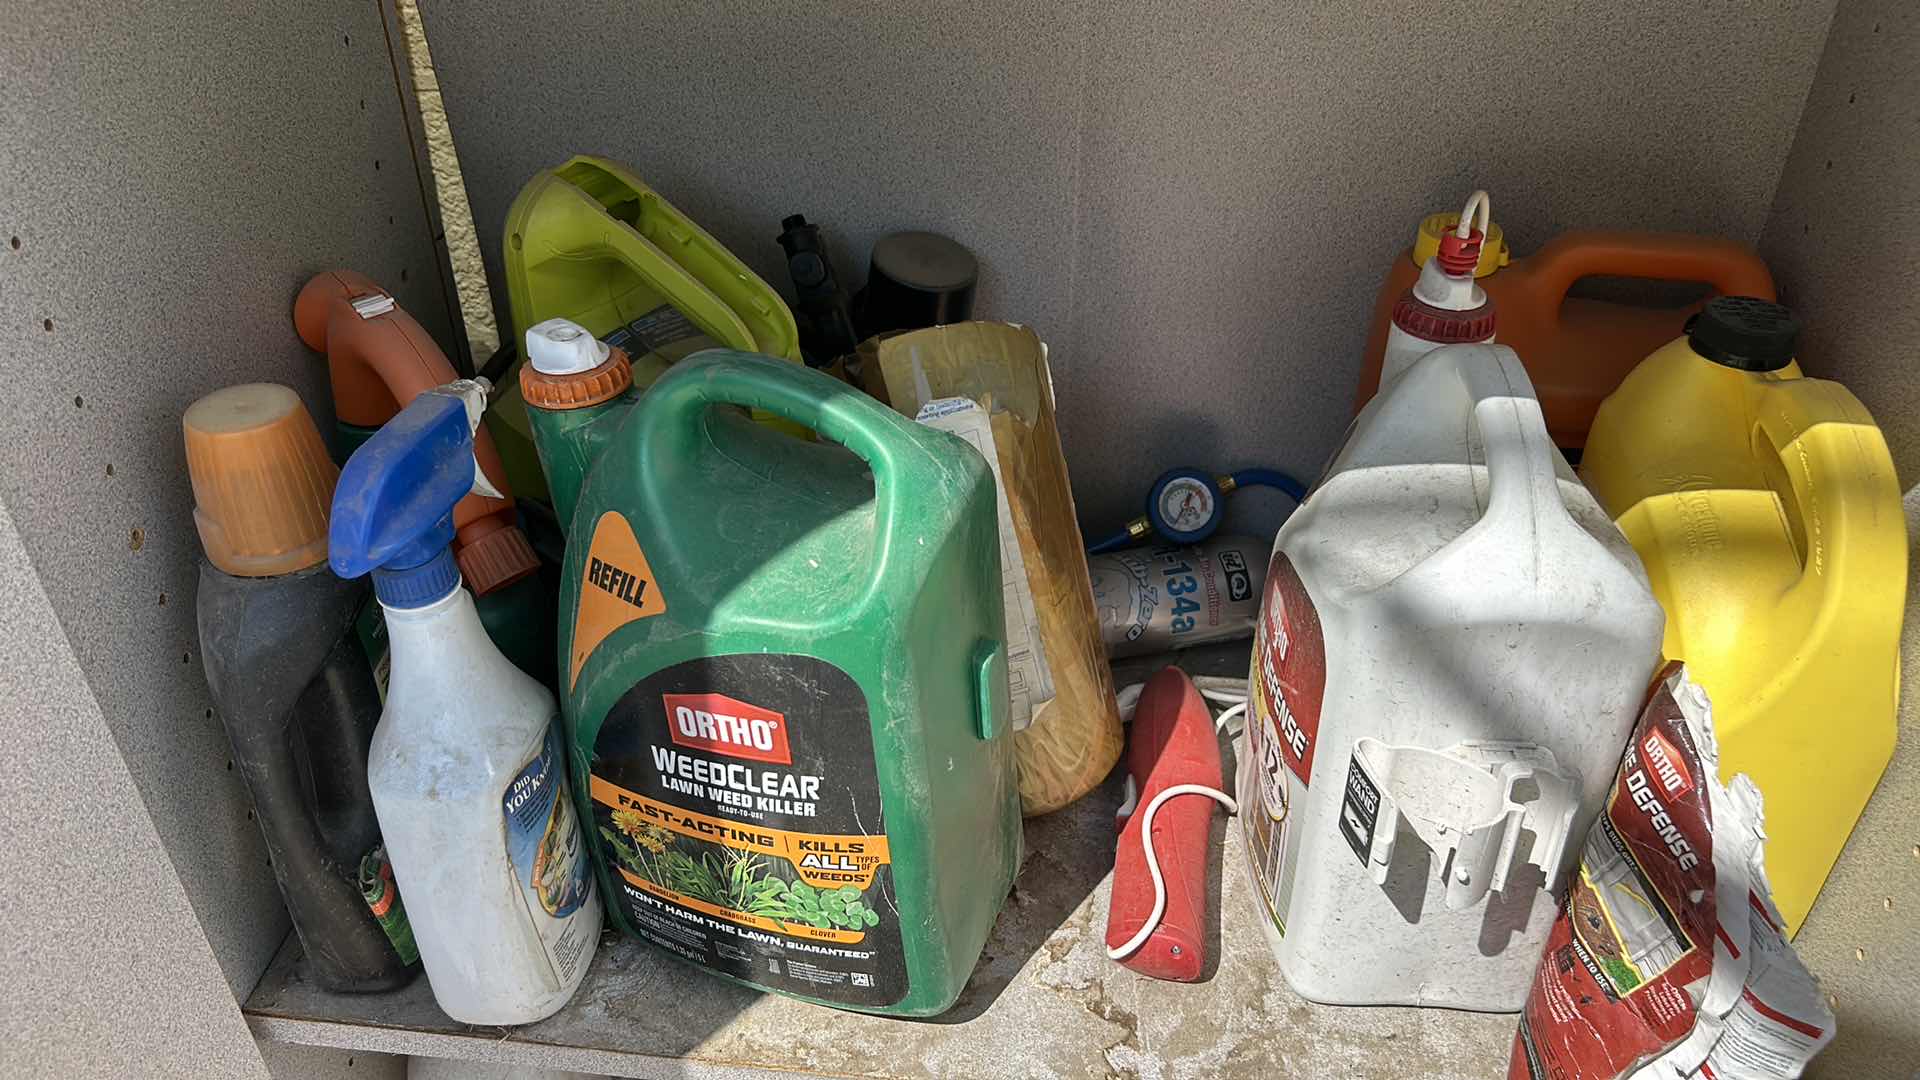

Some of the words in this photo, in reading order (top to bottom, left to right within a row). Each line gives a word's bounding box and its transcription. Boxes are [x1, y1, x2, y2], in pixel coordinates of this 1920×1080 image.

[589, 556, 647, 609] REFILL
[1264, 644, 1308, 762] DEFENSE
[675, 705, 774, 751] ORTHO
[651, 744, 821, 800] WEEDCLEAR
[1644, 735, 1682, 792] ORTHO
[506, 785, 532, 814] YOU
[513, 775, 531, 794] DID
[661, 774, 705, 800] LAWN
[708, 787, 753, 809] WEED
[756, 795, 817, 818] KILLER
[1349, 770, 1375, 815] WAND
[618, 793, 775, 848] FAST-ACTING
[717, 804, 764, 821] READY-TO-USE
[1626, 769, 1699, 872] DEFENSE
[798, 838, 865, 854] KILLS
[799, 853, 860, 872] ALL
[855, 855, 880, 865] TYPES
[861, 863, 871, 871] OF
[623, 884, 664, 909] WON'T
[664, 905, 704, 925] HARM
[706, 918, 736, 935] THE
[738, 928, 784, 948] LAWN,
[719, 908, 757, 924] CRABGRASS
[810, 929, 836, 939] CLOVER
[1571, 938, 1591, 965] WHEN
[1587, 963, 1598, 975] TO
[1672, 987, 1687, 1011] OPEN
